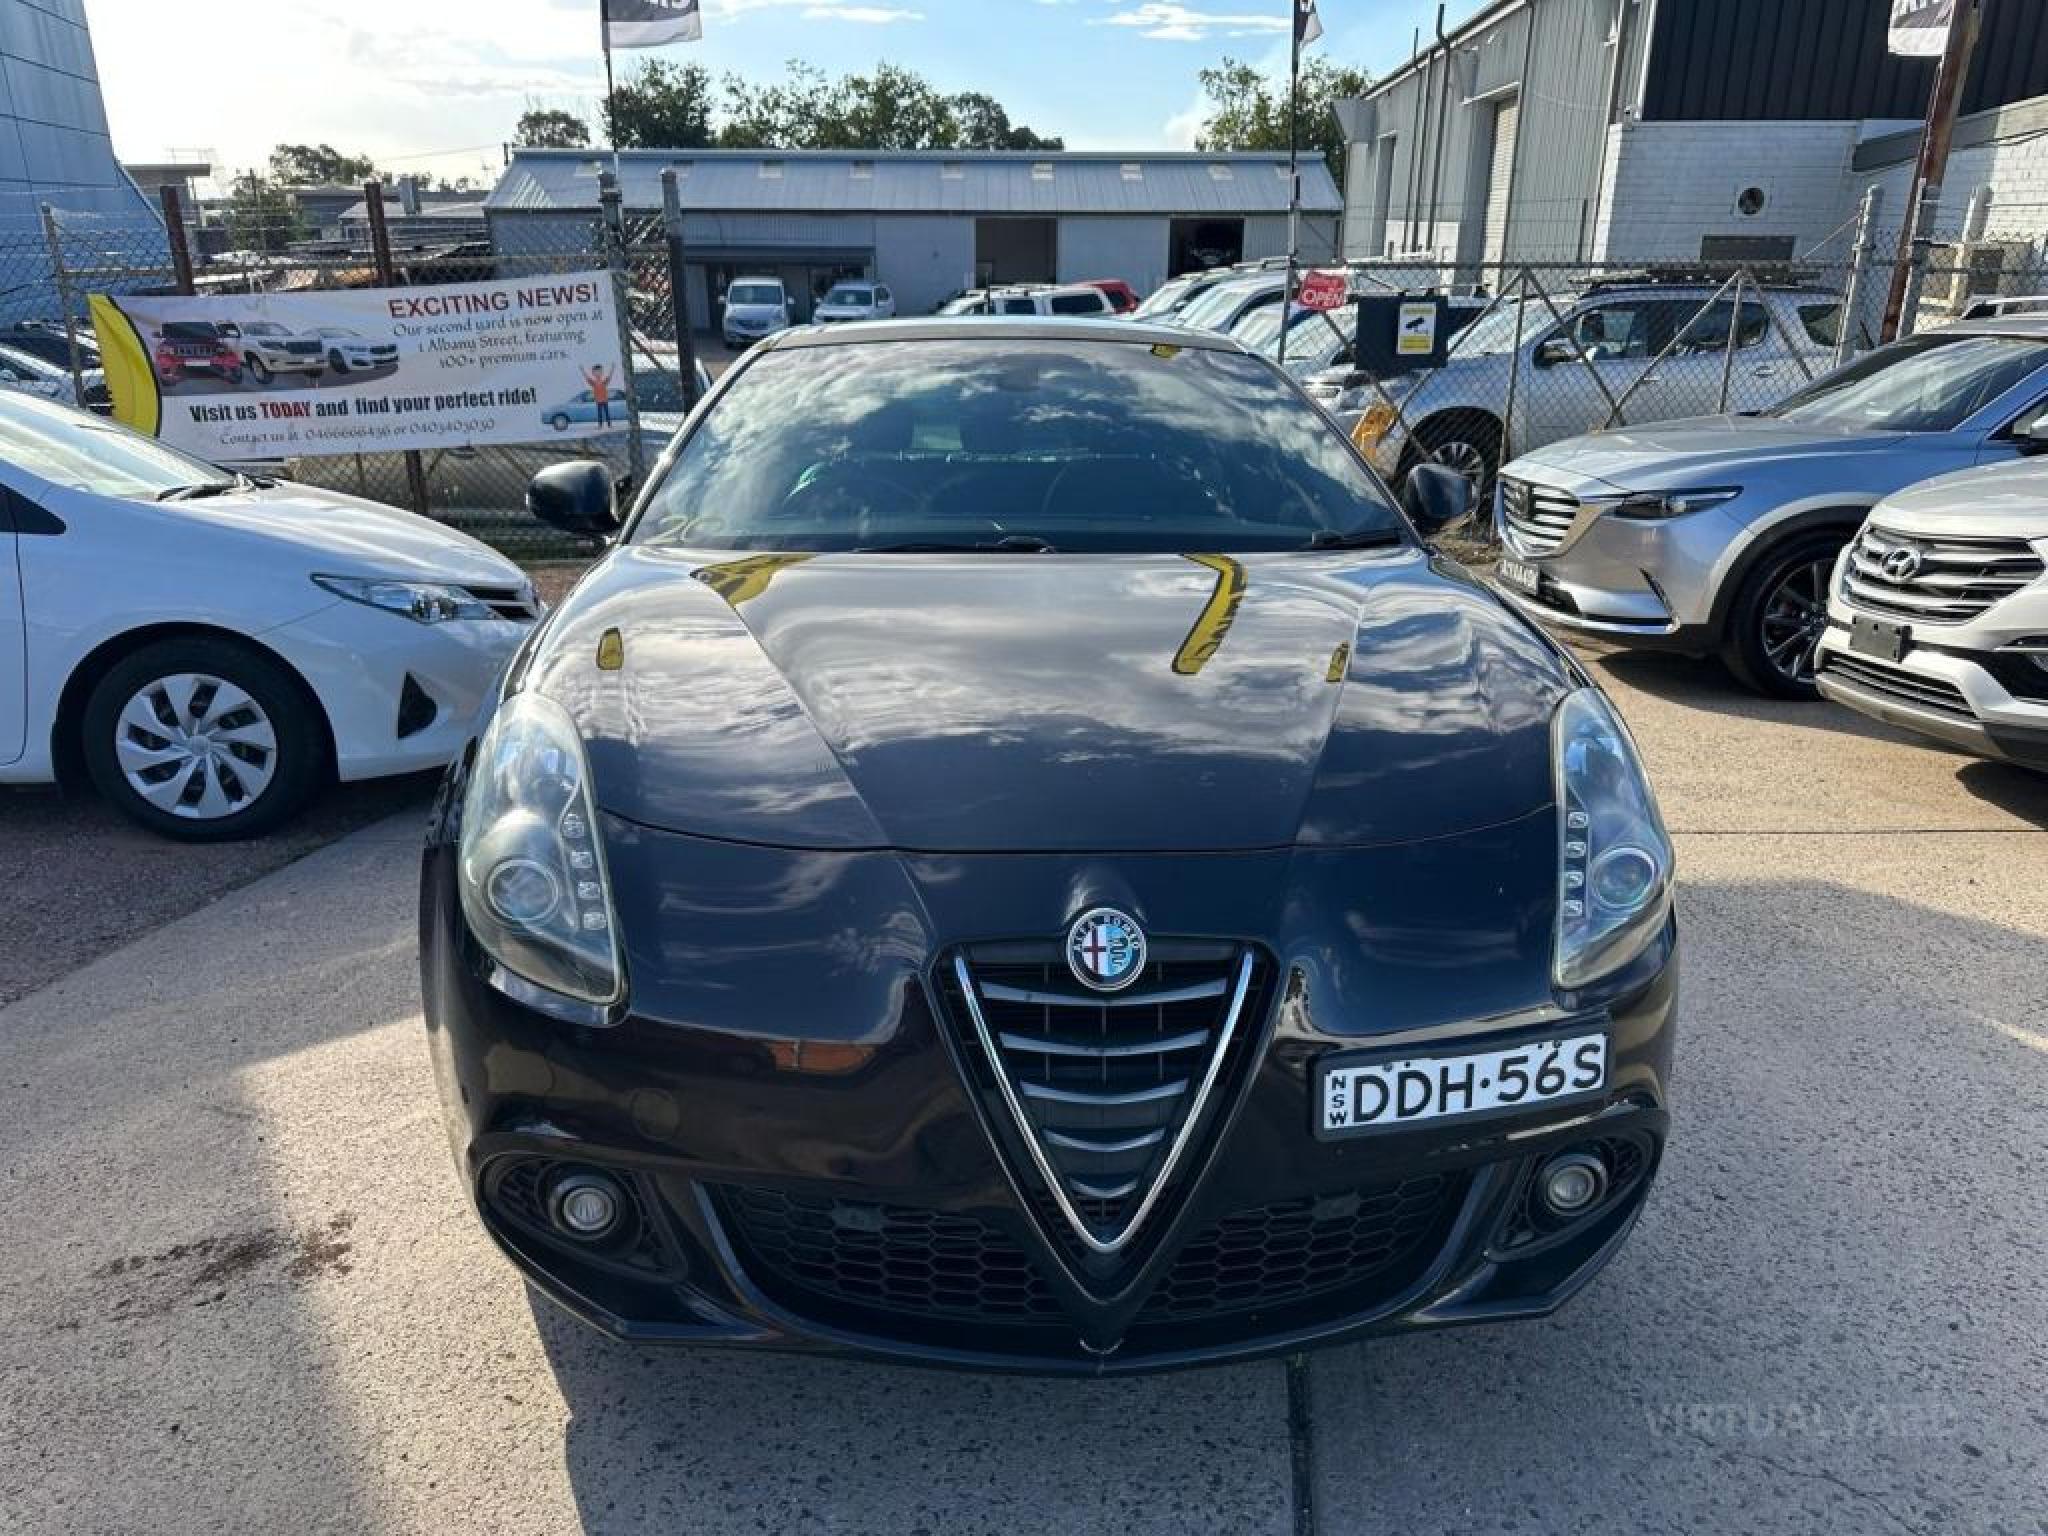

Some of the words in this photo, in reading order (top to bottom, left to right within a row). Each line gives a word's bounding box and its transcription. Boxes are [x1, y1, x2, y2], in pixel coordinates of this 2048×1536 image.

[388, 292, 509, 318] EXCITING
[517, 282, 599, 309] NEWS!
[393, 323, 421, 337] Our
[425, 317, 472, 335] second
[475, 314, 506, 334] yard
[508, 316, 520, 328] is
[523, 313, 552, 327] now
[555, 311, 588, 328] open
[590, 309, 603, 322] at
[428, 337, 476, 353] Albany
[479, 333, 523, 350] Street,
[525, 328, 587, 345] featuring
[479, 352, 537, 369] premium
[189, 404, 233, 422] Visit
[235, 405, 257, 421] us
[259, 401, 311, 419] TODAY
[315, 399, 349, 417] and
[355, 396, 390, 415] find
[392, 396, 431, 415] your
[434, 390, 495, 412] perfect
[497, 386, 537, 405] ride!
[220, 432, 267, 446] Contact
[271, 432, 285, 443] us
[394, 427, 406, 436] or
[1329, 1075, 1348, 1126] NSW
